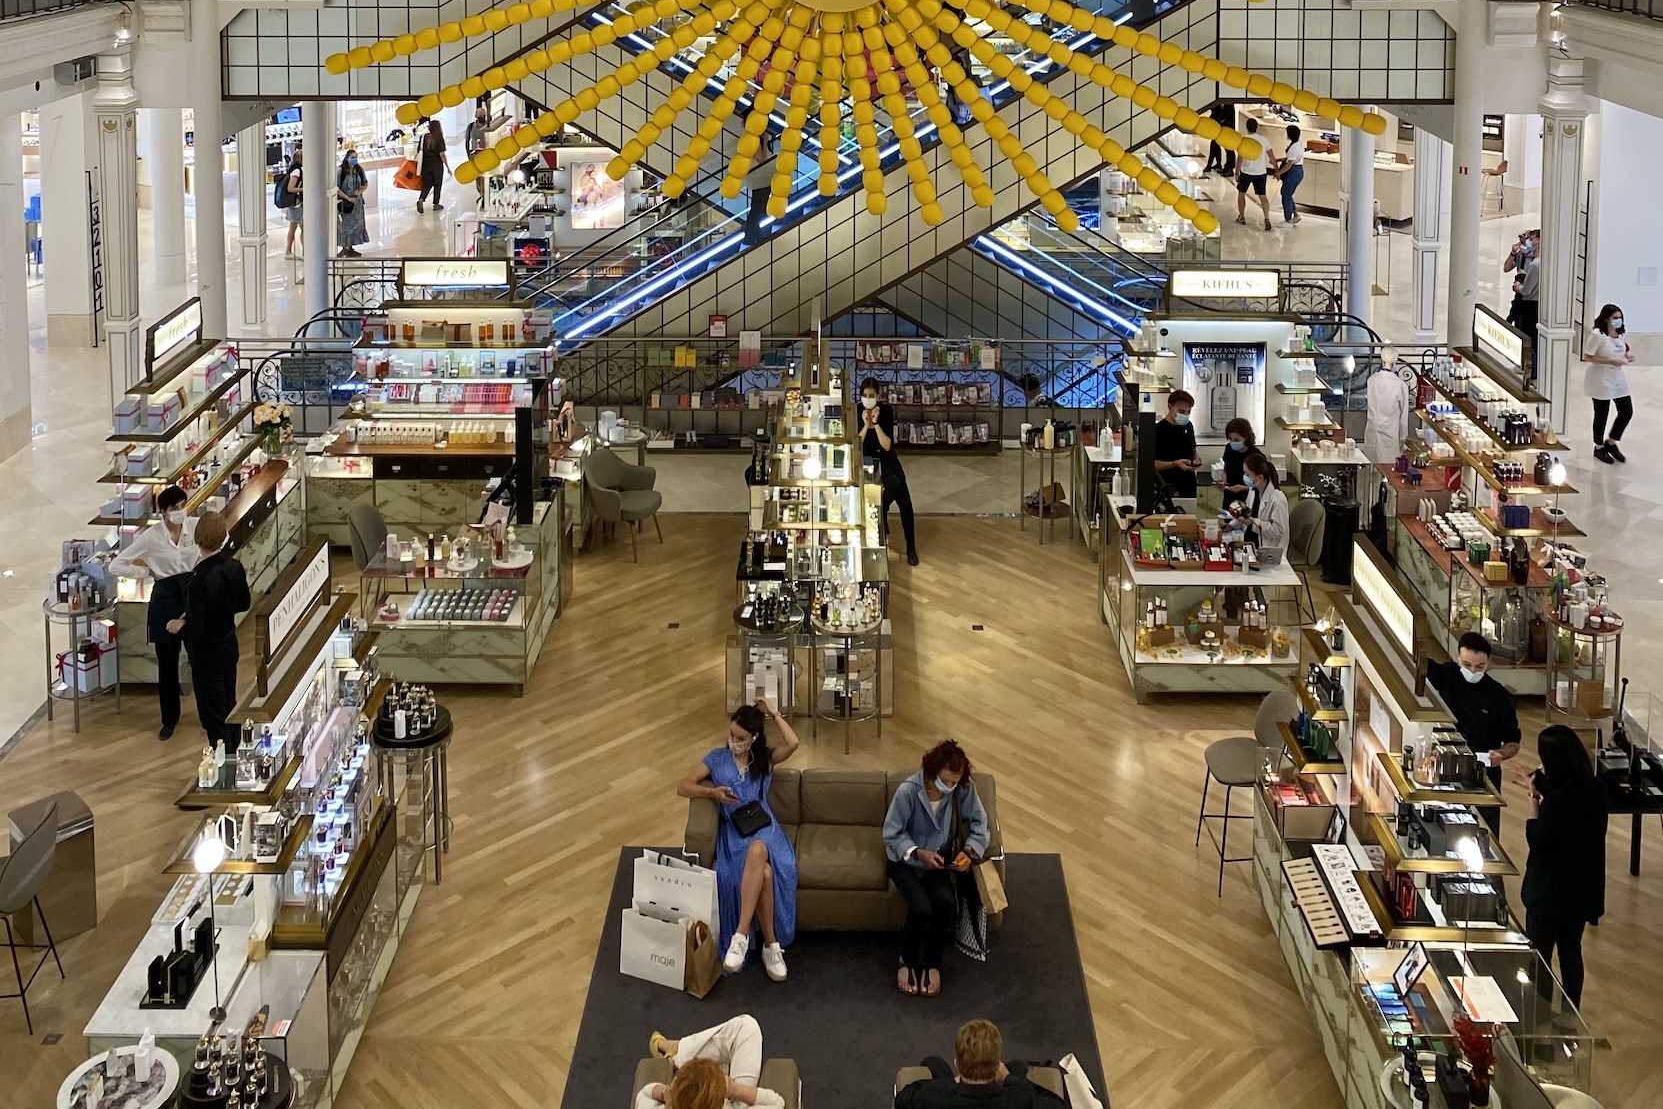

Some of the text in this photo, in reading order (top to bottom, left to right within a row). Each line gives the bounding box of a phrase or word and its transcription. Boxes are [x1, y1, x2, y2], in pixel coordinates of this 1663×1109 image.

[94, 205, 100, 224] 3
[93, 227, 101, 246] 2
[435, 264, 477, 279] fresh
[1203, 279, 1253, 290] KIEHL'S
[168, 315, 188, 340] fresh
[272, 554, 326, 633] PENHALIGON'S
[654, 875, 692, 888] sandro
[650, 952, 676, 967] maje
